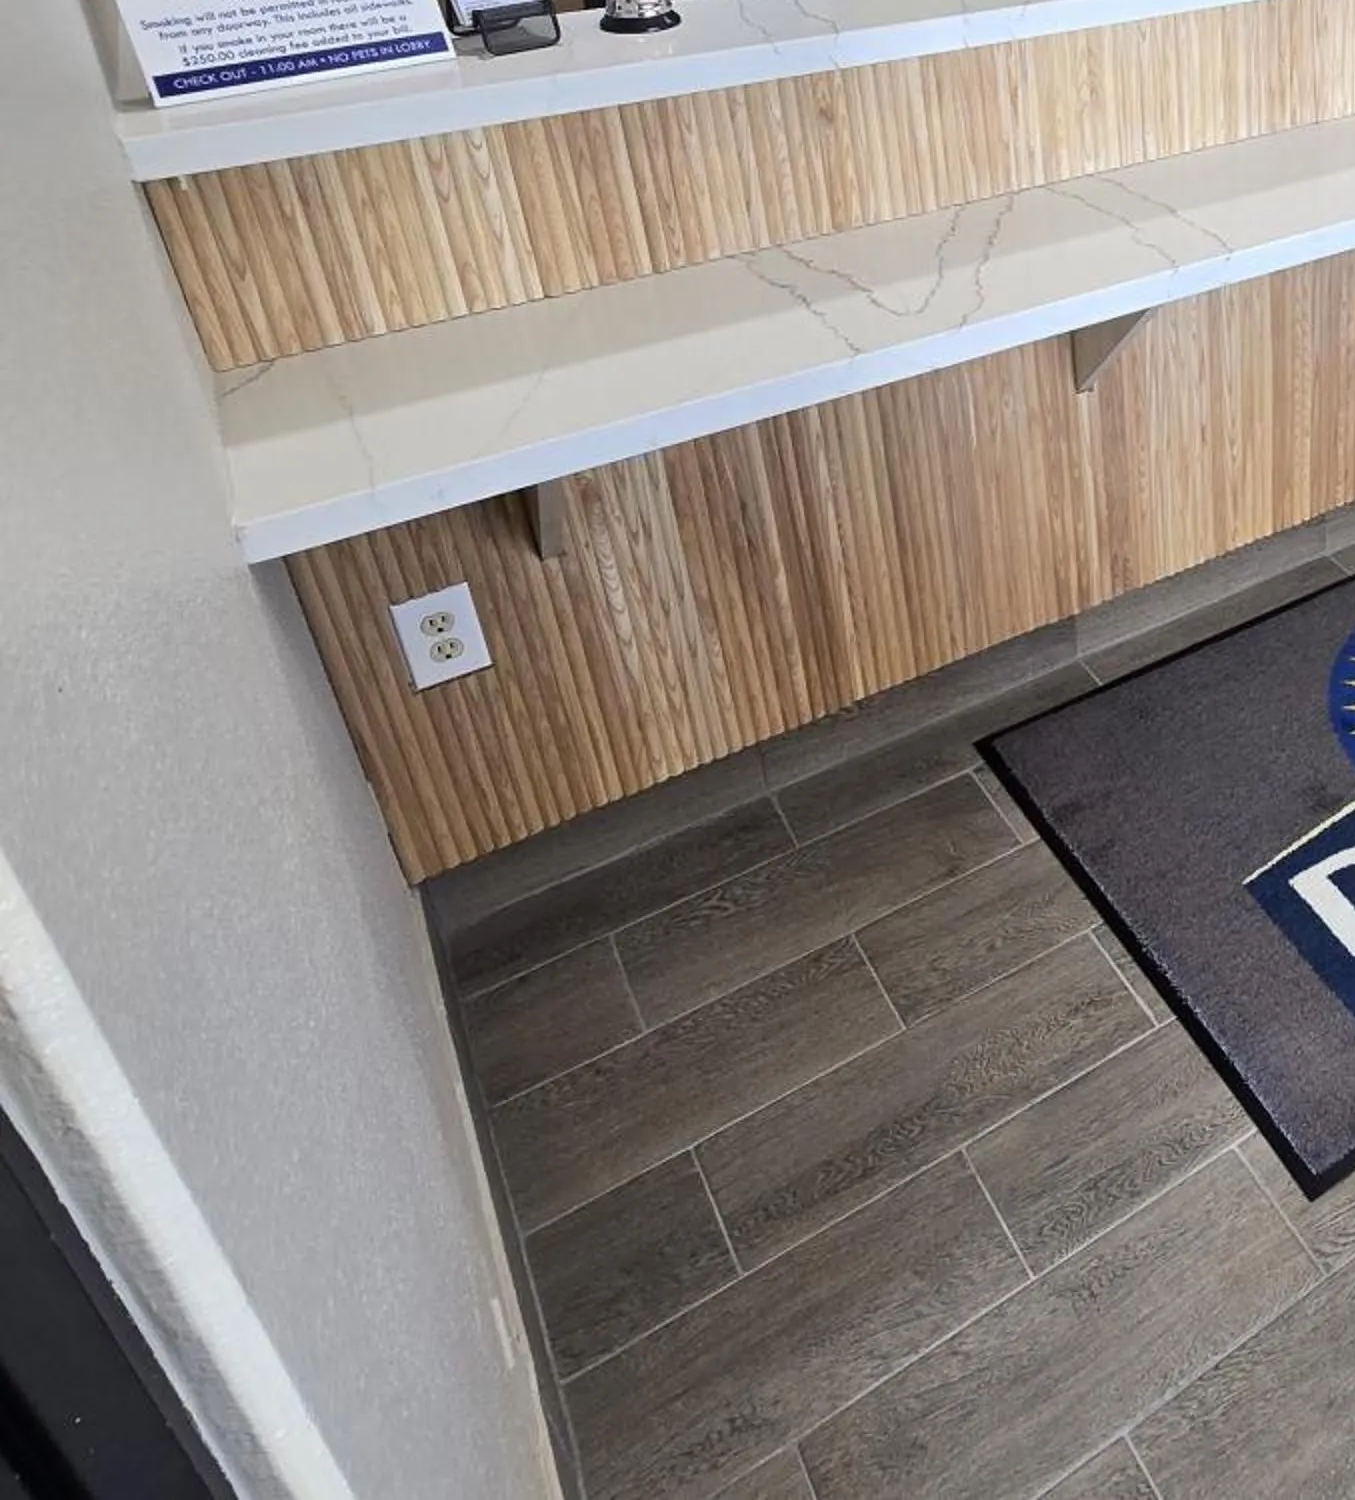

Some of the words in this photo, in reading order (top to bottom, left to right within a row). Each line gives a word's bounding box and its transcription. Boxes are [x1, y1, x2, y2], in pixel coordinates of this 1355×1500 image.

[140, 16, 192, 32] Smoking
[195, 11, 216, 21] will
[218, 9, 237, 19] not
[240, 6, 256, 16] be
[159, 29, 188, 40] from
[191, 27, 213, 37] any
[273, 11, 295, 22] This
[297, 7, 341, 20] includes
[343, 3, 358, 15] all
[192, 43, 214, 54] you
[217, 36, 253, 49] smoke
[255, 33, 268, 43] in
[270, 30, 294, 43] your
[298, 25, 327, 35] room
[329, 21, 357, 33] there
[360, 16, 380, 28] will
[381, 14, 396, 25] be
[172, 72, 219, 89] CHECK
[220, 67, 248, 81] OUT
[259, 58, 295, 76] 11:00
[299, 56, 319, 70] AM
[328, 52, 350, 65] NO
[351, 47, 380, 61] PETS
[380, 45, 394, 56] IN
[395, 39, 433, 53] LOBBY
[181, 50, 235, 67] $250.00
[239, 44, 287, 59] cleaning
[289, 39, 309, 50] fee
[312, 32, 349, 47] added
[367, 28, 390, 41] your
